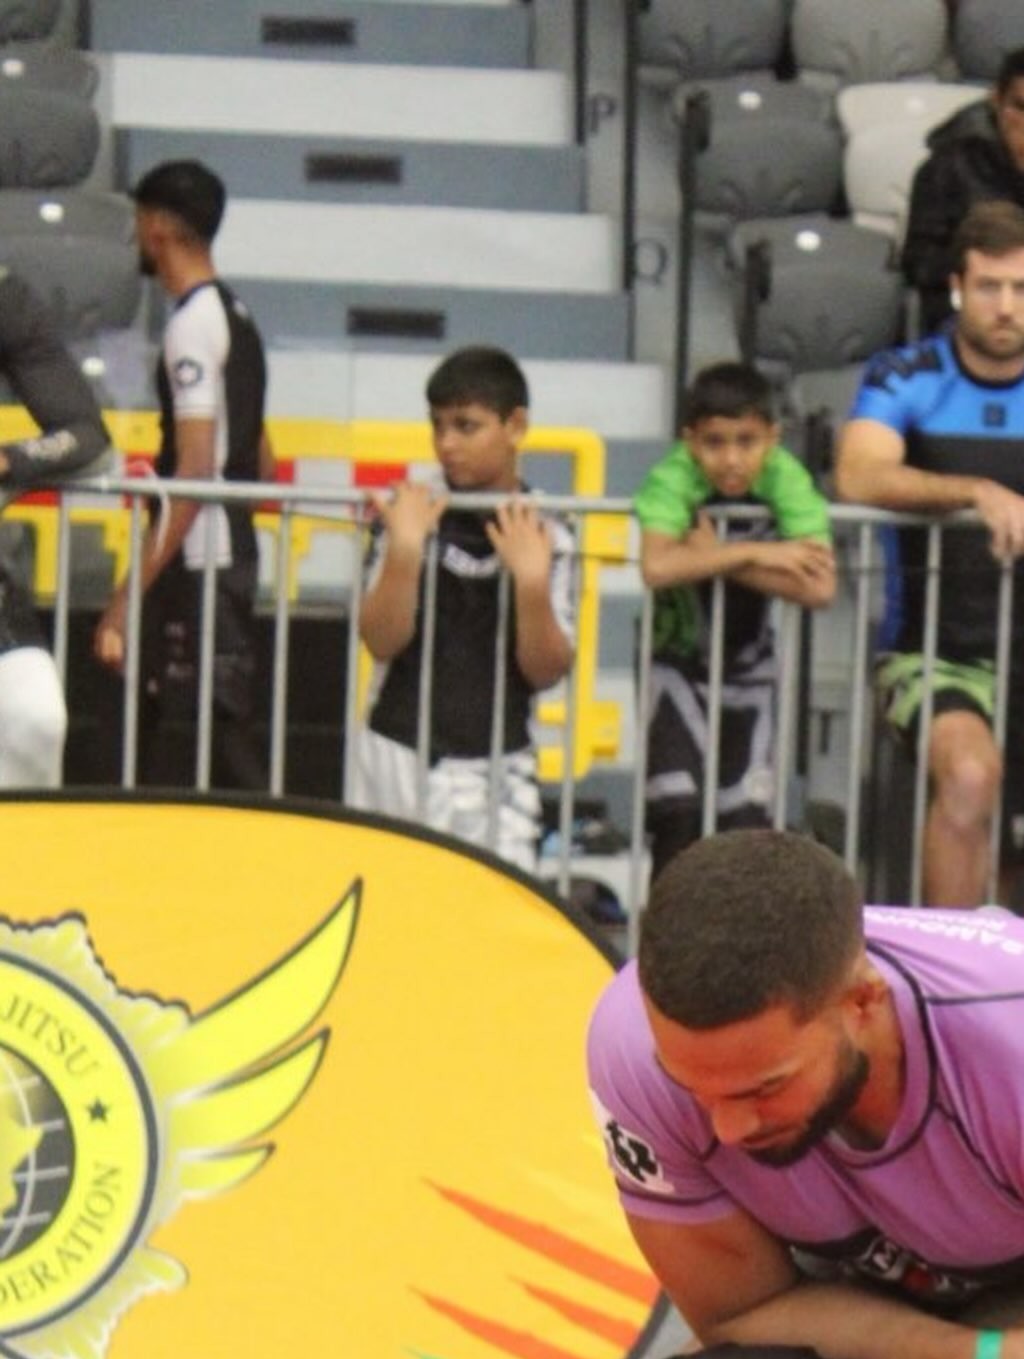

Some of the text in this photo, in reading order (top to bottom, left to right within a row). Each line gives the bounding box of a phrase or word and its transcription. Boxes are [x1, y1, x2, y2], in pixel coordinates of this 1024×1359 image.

[590, 93, 617, 137] P
[634, 237, 669, 287] Q
[0, 994, 99, 1078] JITSU
